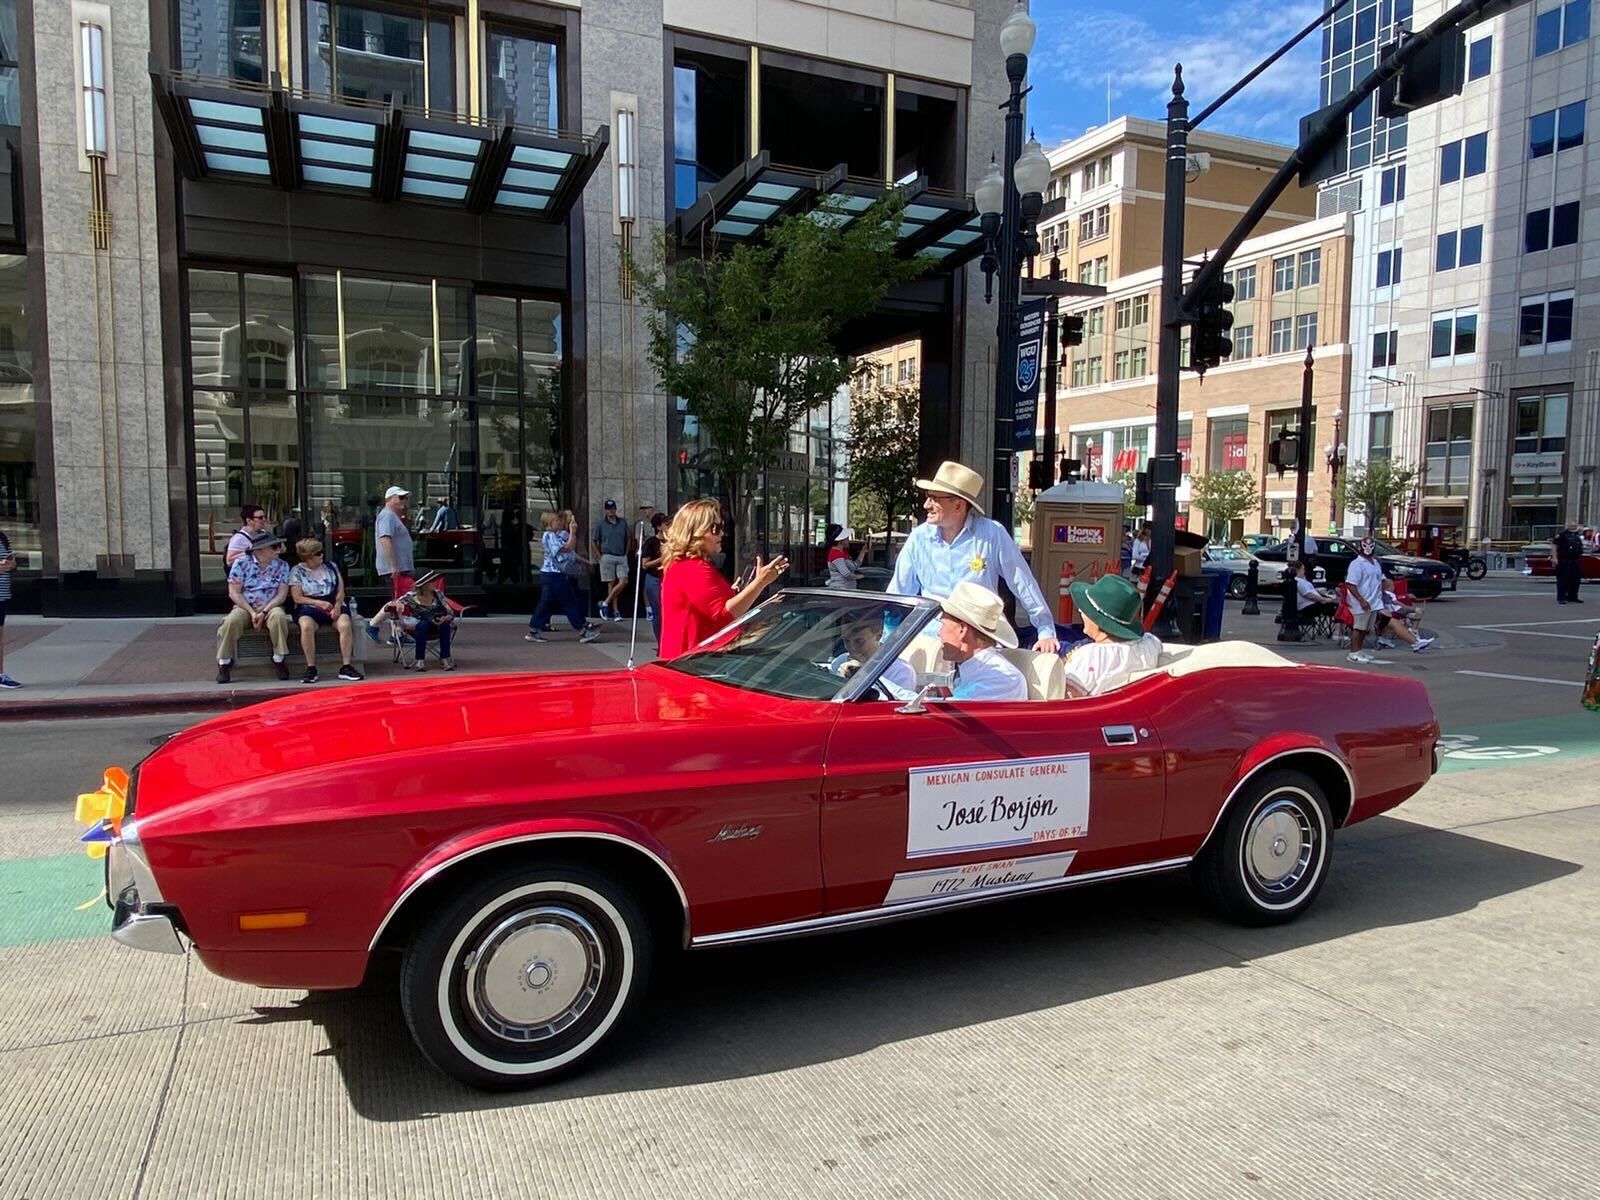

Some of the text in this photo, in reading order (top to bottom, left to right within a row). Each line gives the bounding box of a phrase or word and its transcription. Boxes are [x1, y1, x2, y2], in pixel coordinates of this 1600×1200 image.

[1020, 345, 1037, 358] WGU
[1229, 443, 1248, 458] Sal
[1090, 455, 1104, 467] Sal
[1067, 525, 1101, 536] Honey
[1067, 535, 1103, 544] Bucket
[927, 763, 1068, 787] MEXICAN CONSULATE GENERAL
[936, 794, 1058, 831] José Borjón
[1033, 830, 1057, 842] DAYS
[1058, 828, 1069, 839] OF
[960, 860, 1015, 874] KENT SWAN
[931, 871, 1034, 893] 1972 Mustang
